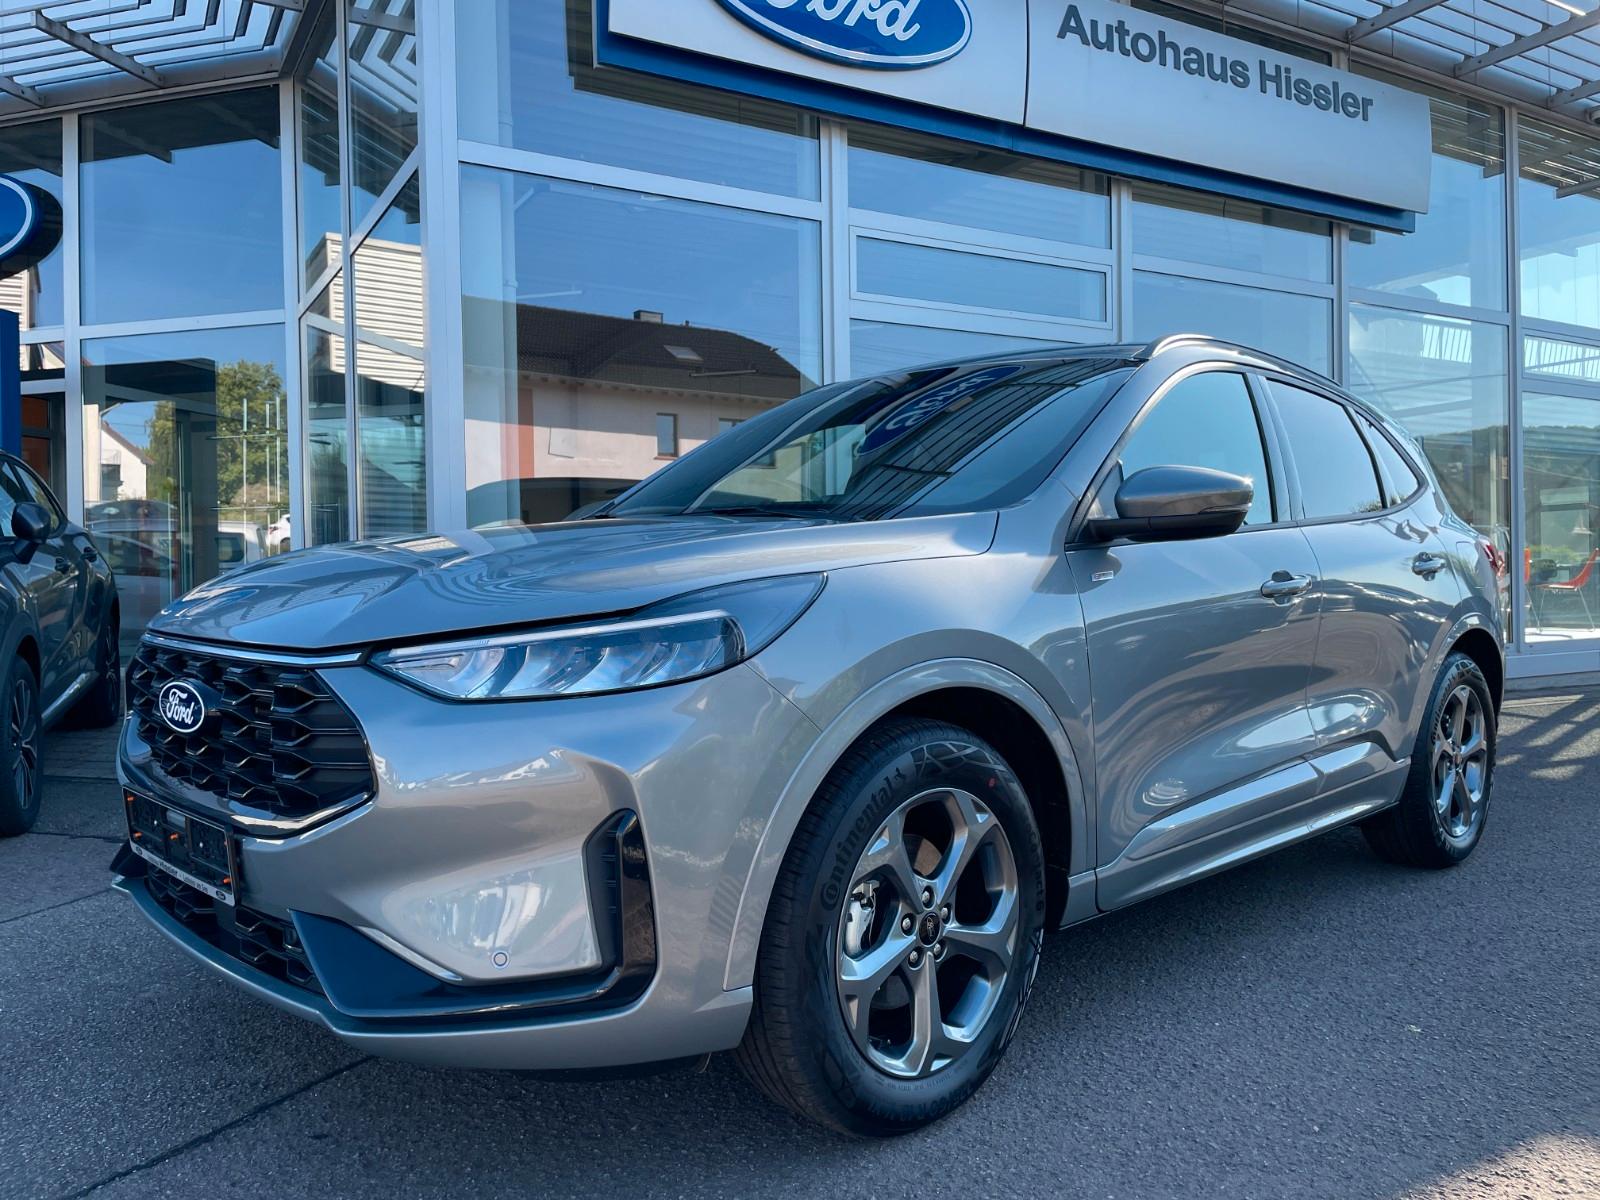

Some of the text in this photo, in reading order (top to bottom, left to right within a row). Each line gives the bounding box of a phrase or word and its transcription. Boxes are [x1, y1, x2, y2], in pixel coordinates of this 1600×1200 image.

[765, 0, 920, 41] ord
[1056, 3, 1373, 122] Autohaus Hissler
[166, 688, 195, 725] Ford
[820, 775, 894, 911] Continental
